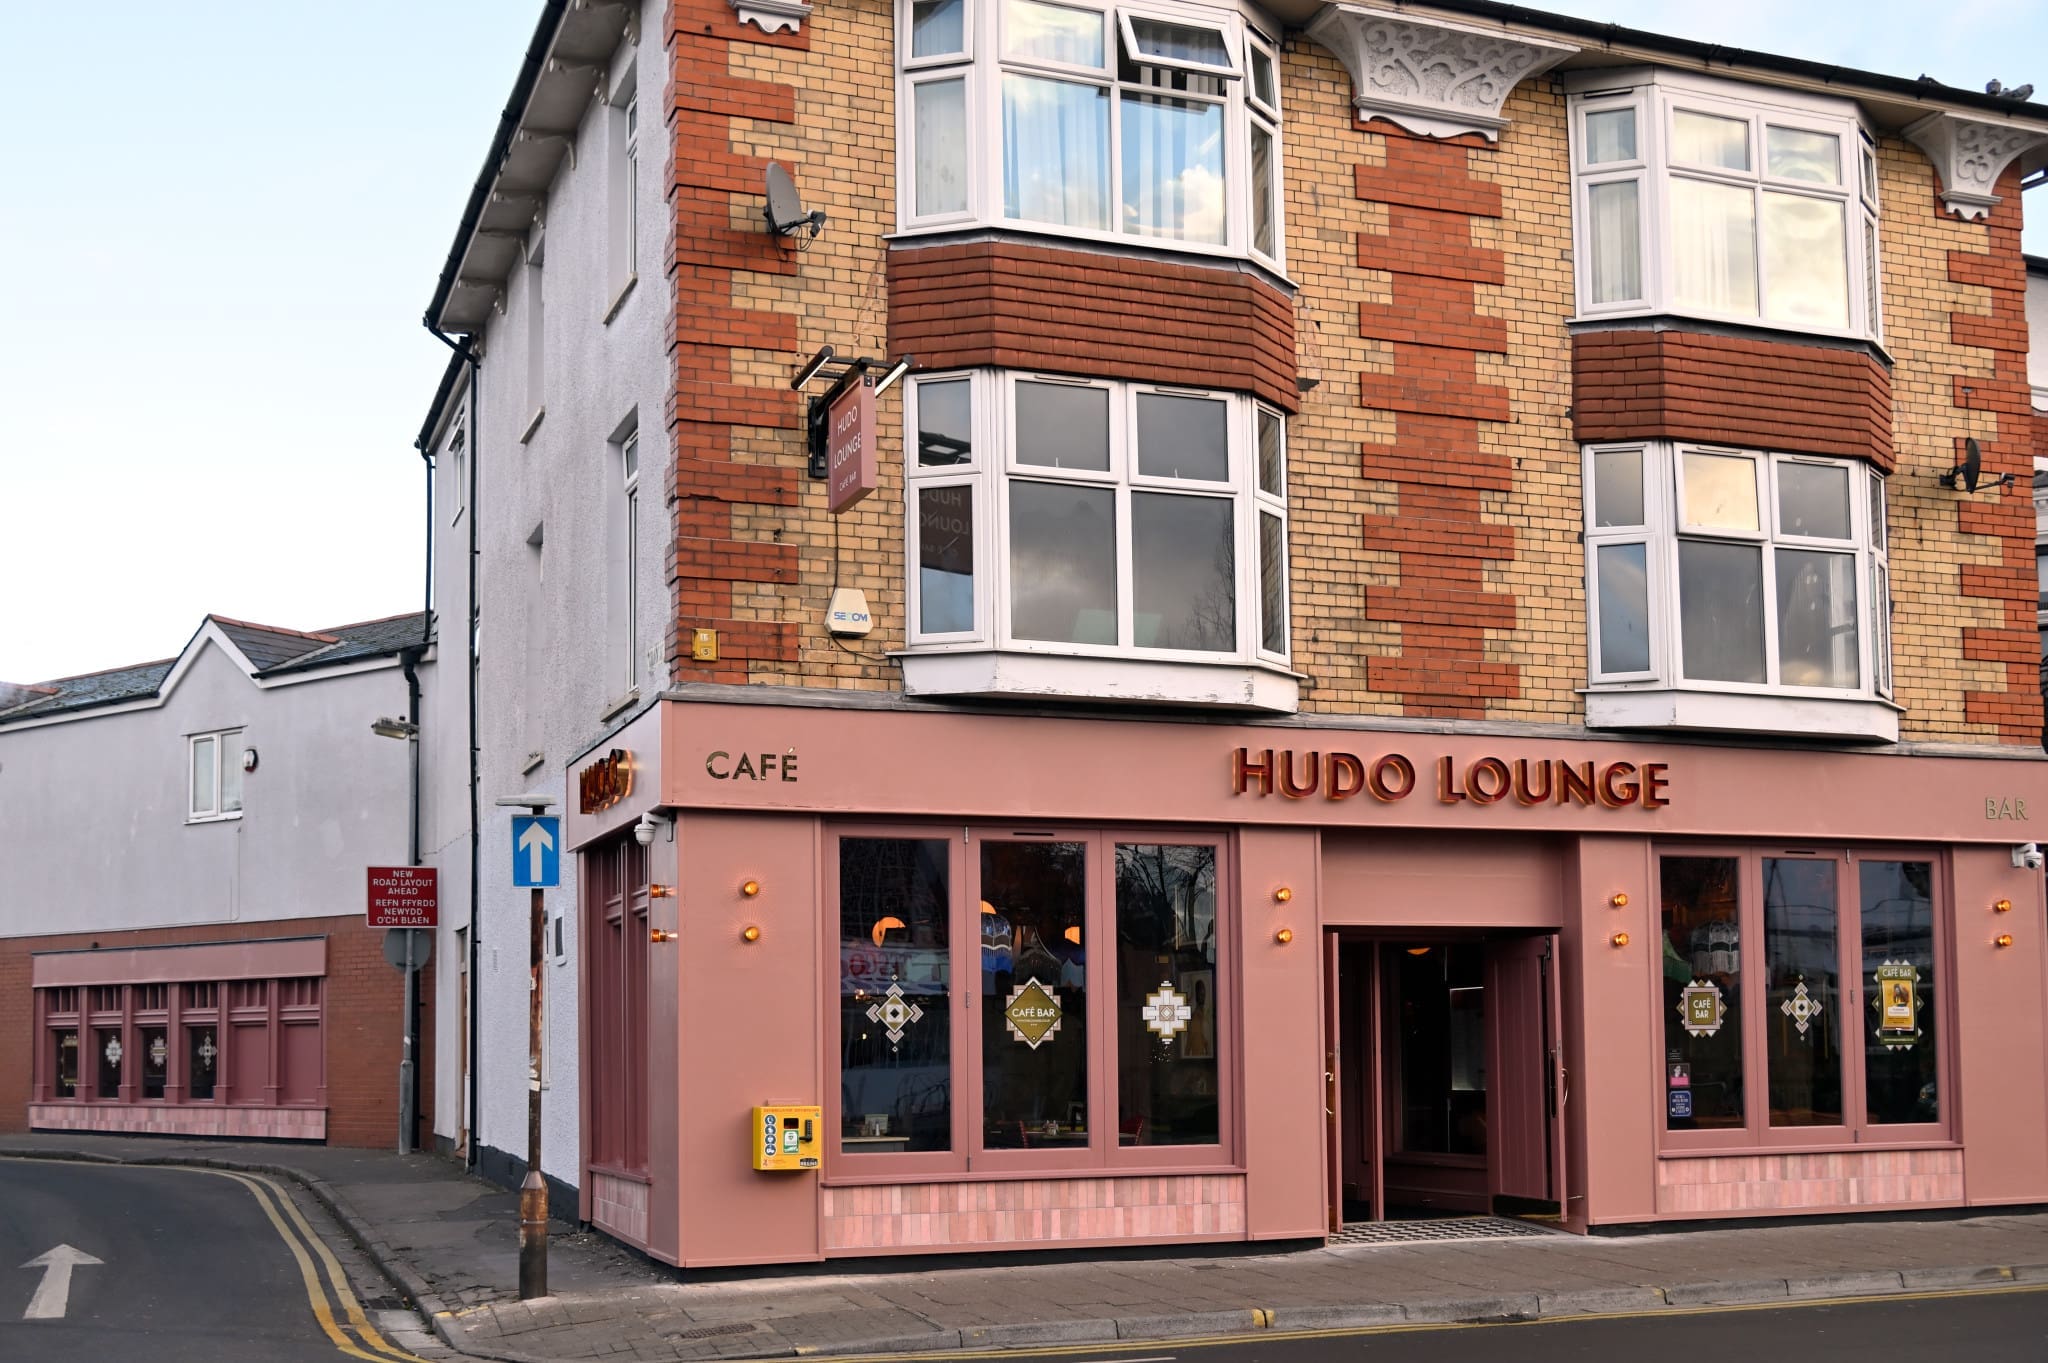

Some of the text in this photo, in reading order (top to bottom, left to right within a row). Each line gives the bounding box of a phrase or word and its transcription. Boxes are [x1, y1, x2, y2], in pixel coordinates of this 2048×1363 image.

[837, 405, 858, 436] HUDO
[834, 432, 861, 469] LOUNGE
[706, 747, 797, 782] CAFÉ
[1233, 747, 1670, 808] HUDO LOUNGE
[1985, 796, 2029, 821] BAR
[375, 899, 436, 907] REFN FFYRDD
[1882, 966, 1912, 977] CAFÉ BAR
[1012, 1006, 1055, 1017] CAFÉ BAR
[1693, 997, 1712, 1008] CAFÉ
[1695, 1009, 1709, 1019] BAR
